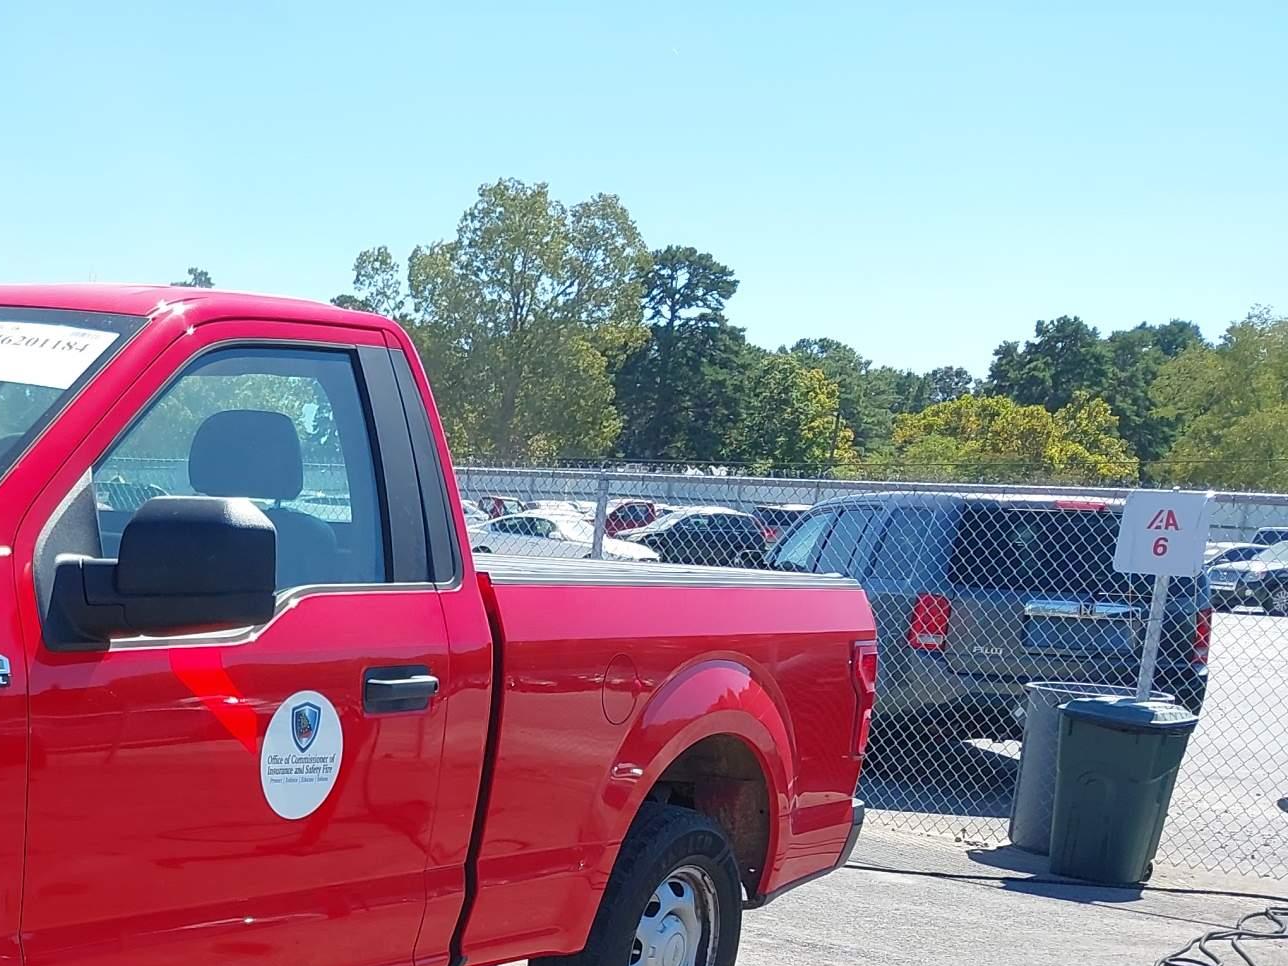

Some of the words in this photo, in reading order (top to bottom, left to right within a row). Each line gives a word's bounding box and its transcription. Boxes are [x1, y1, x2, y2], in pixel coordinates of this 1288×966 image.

[1152, 536, 1169, 556] 6
[267, 754, 283, 765] Office
[284, 754, 291, 765] of
[292, 753, 329, 764] Commissioner
[267, 765, 294, 776] Insurance
[294, 765, 304, 774] and
[305, 764, 322, 776] Safety
[322, 764, 333, 774] Fire
